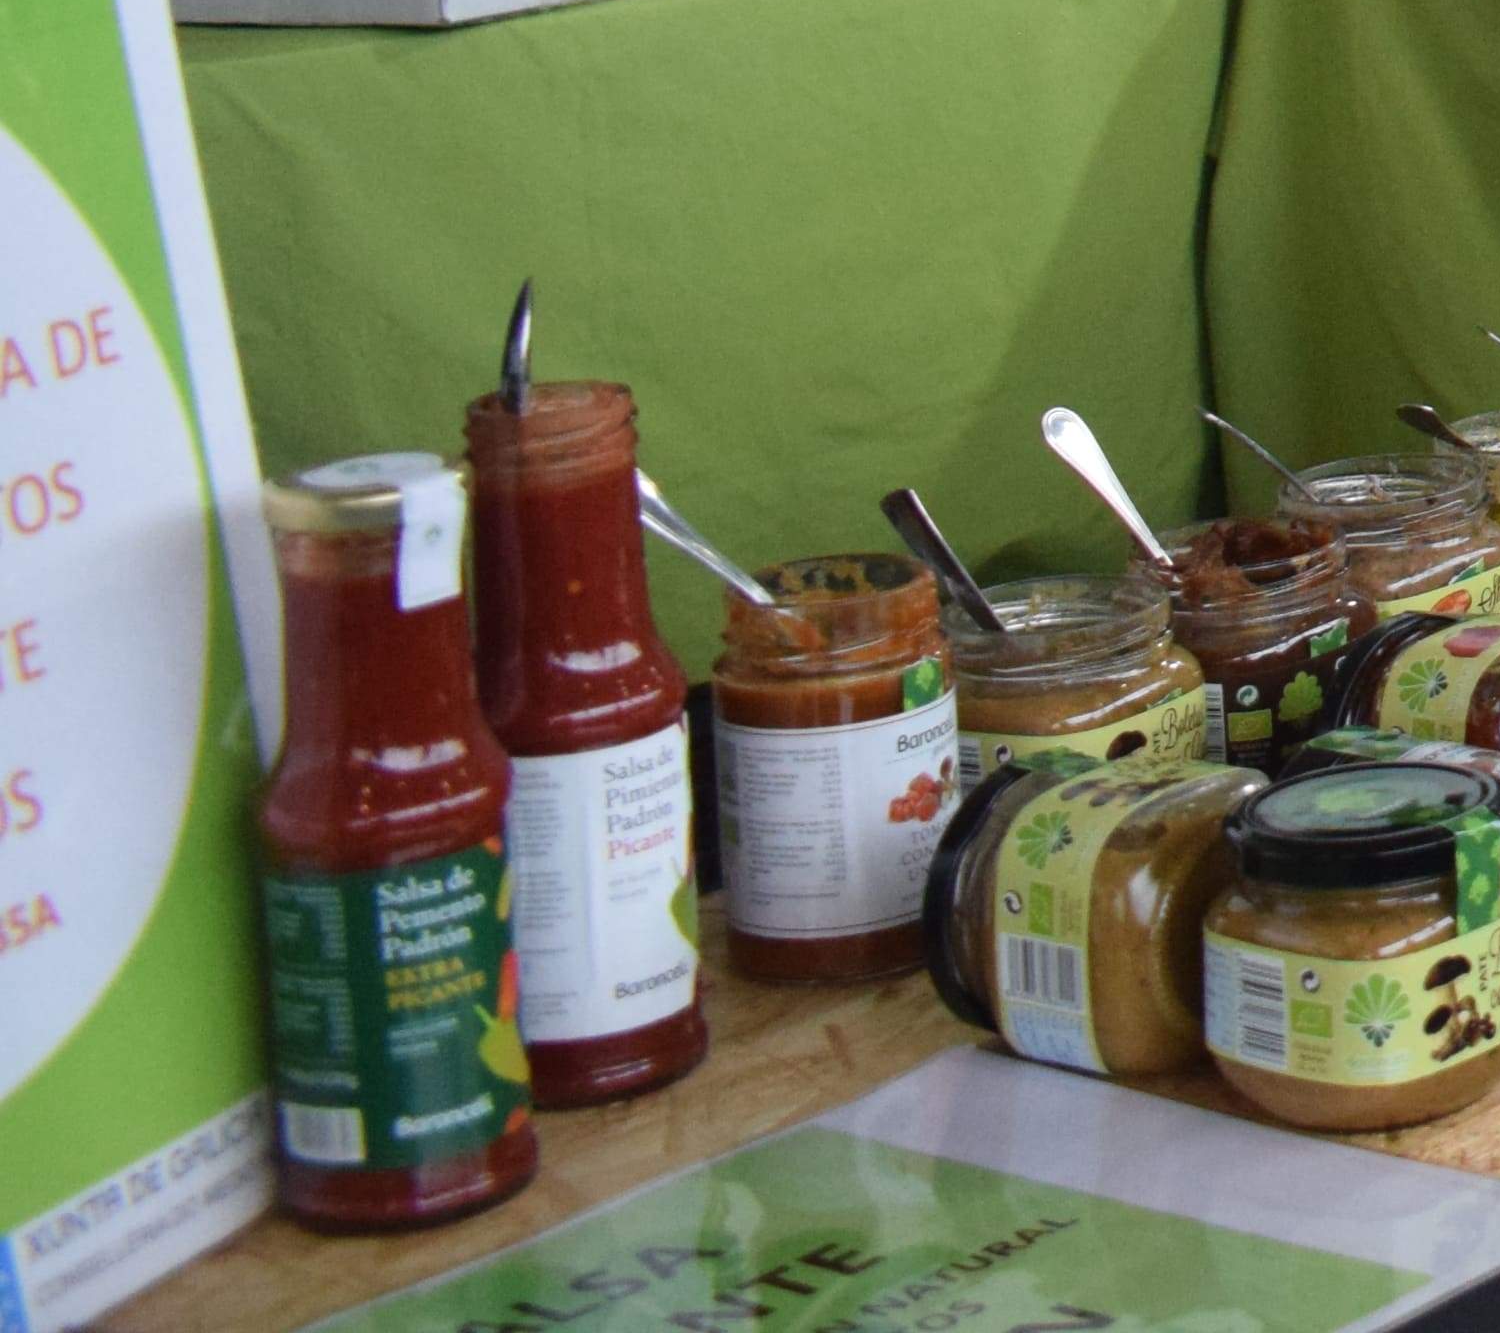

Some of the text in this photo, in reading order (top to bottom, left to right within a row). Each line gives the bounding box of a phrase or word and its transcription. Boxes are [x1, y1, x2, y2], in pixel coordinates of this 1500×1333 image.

[0, 305, 121, 398] A DE
[0, 460, 86, 534] OS
[602, 744, 674, 784] Salsa de
[606, 799, 675, 835] Padrón
[377, 864, 476, 907] Salsa de
[860, 1214, 1080, 1317] NATURAL
